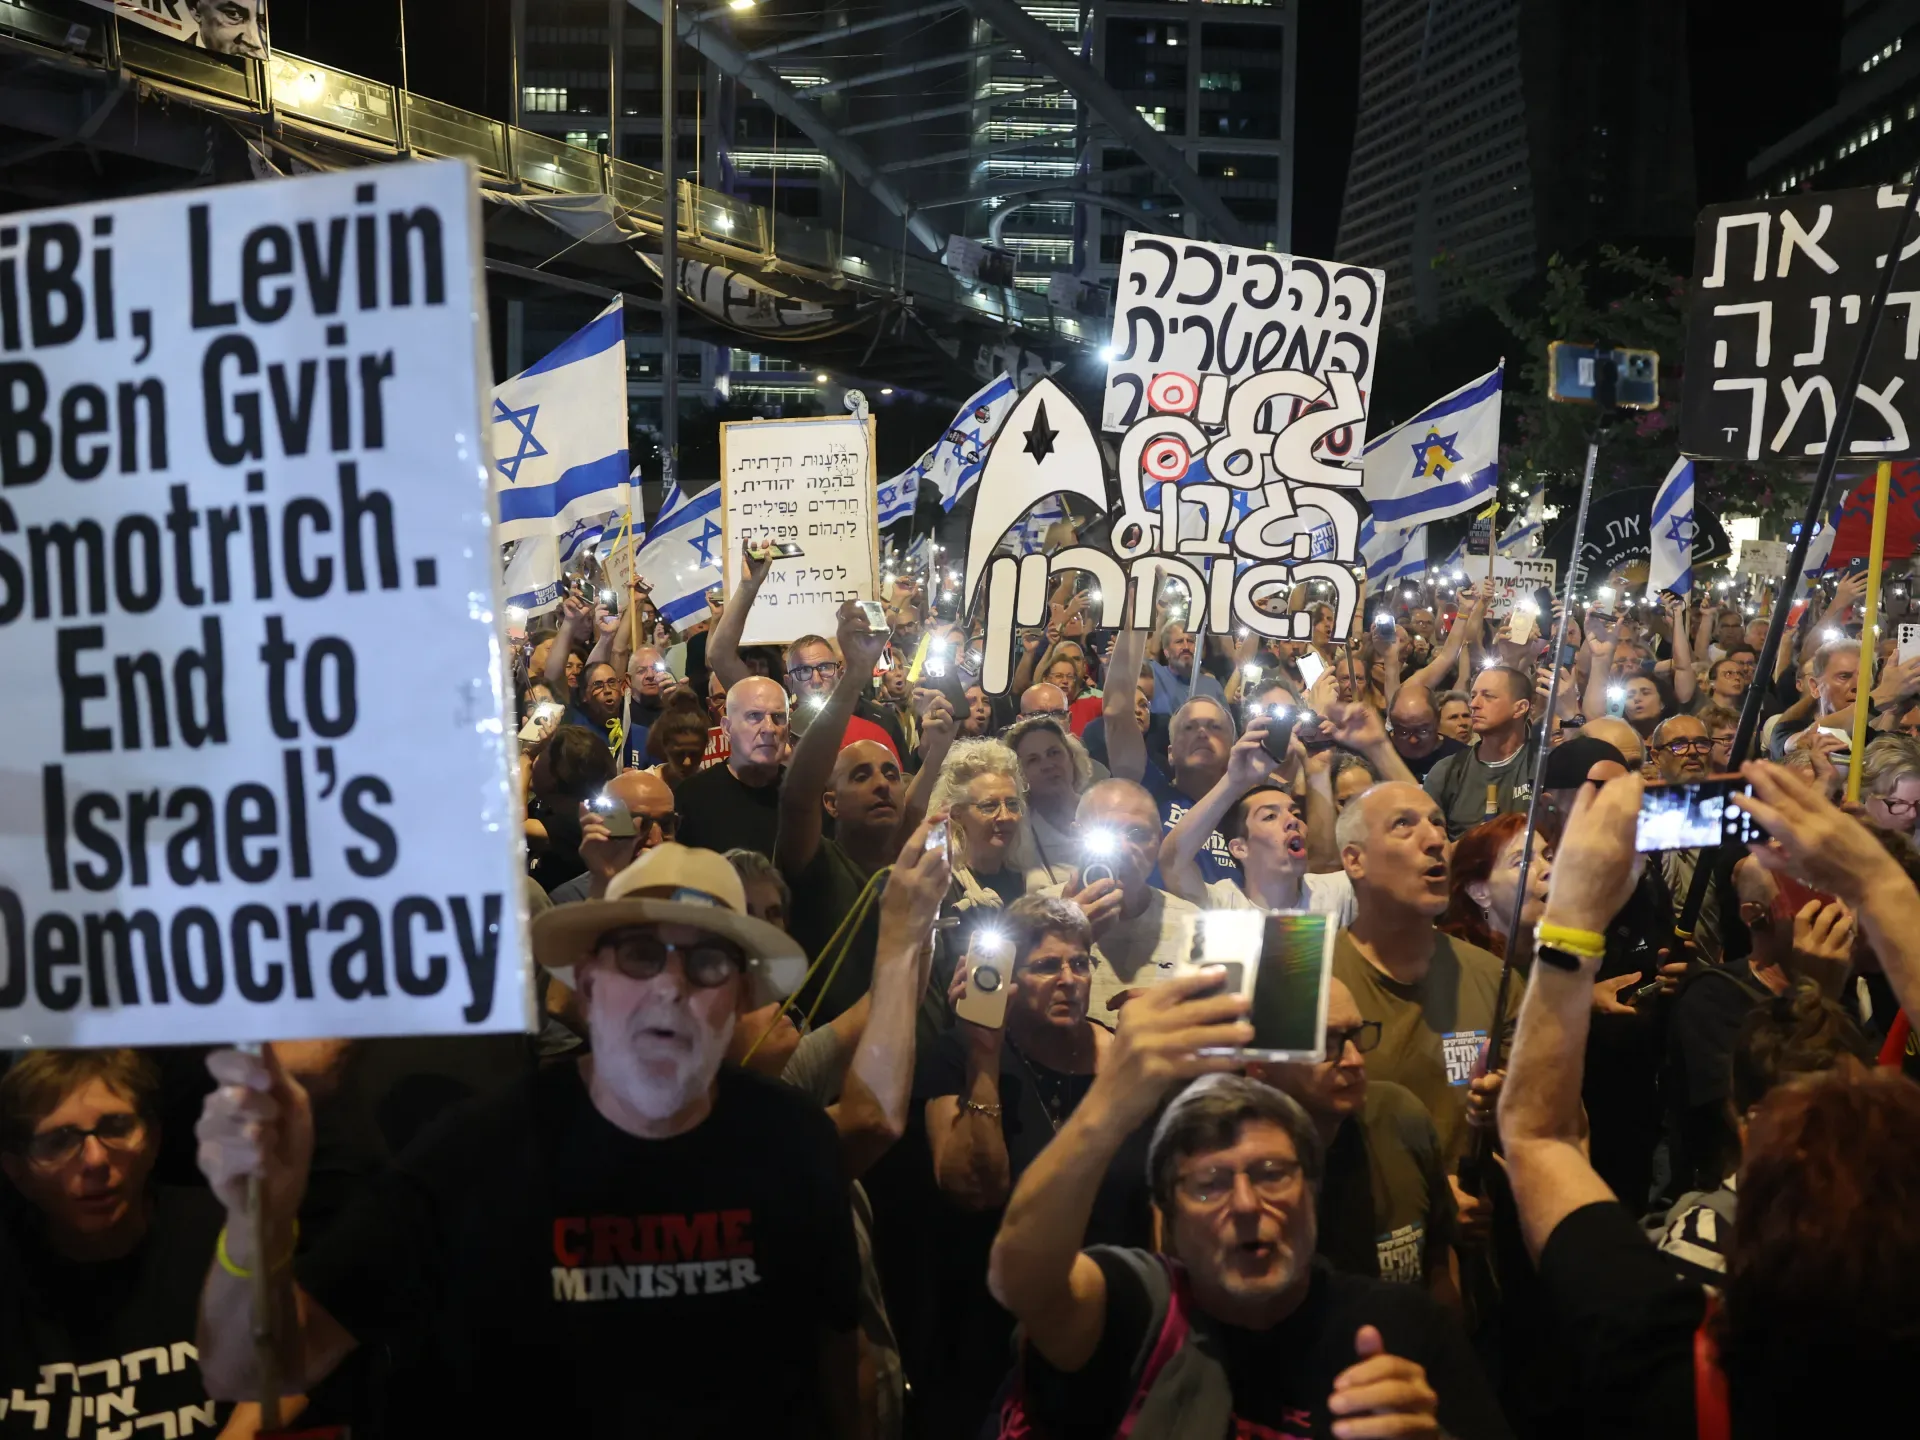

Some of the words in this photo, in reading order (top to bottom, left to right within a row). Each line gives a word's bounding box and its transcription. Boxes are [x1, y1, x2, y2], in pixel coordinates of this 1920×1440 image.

[188, 182, 446, 330] Levin
[1702, 203, 1840, 289] את
[1129, 238, 1378, 328] ההפיכה
[0, 360, 168, 488] Ben
[203, 324, 395, 467] Gvir
[1606, 514, 1640, 547] את
[795, 565, 847, 587] לסלק
[1514, 560, 1554, 576] הדרך
[57, 614, 228, 755] End
[259, 614, 358, 740] to
[43, 746, 398, 892] Israel's
[554, 1209, 754, 1267] CRIME
[550, 1257, 762, 1301] MINISTER
[66, 1386, 140, 1439] אין
